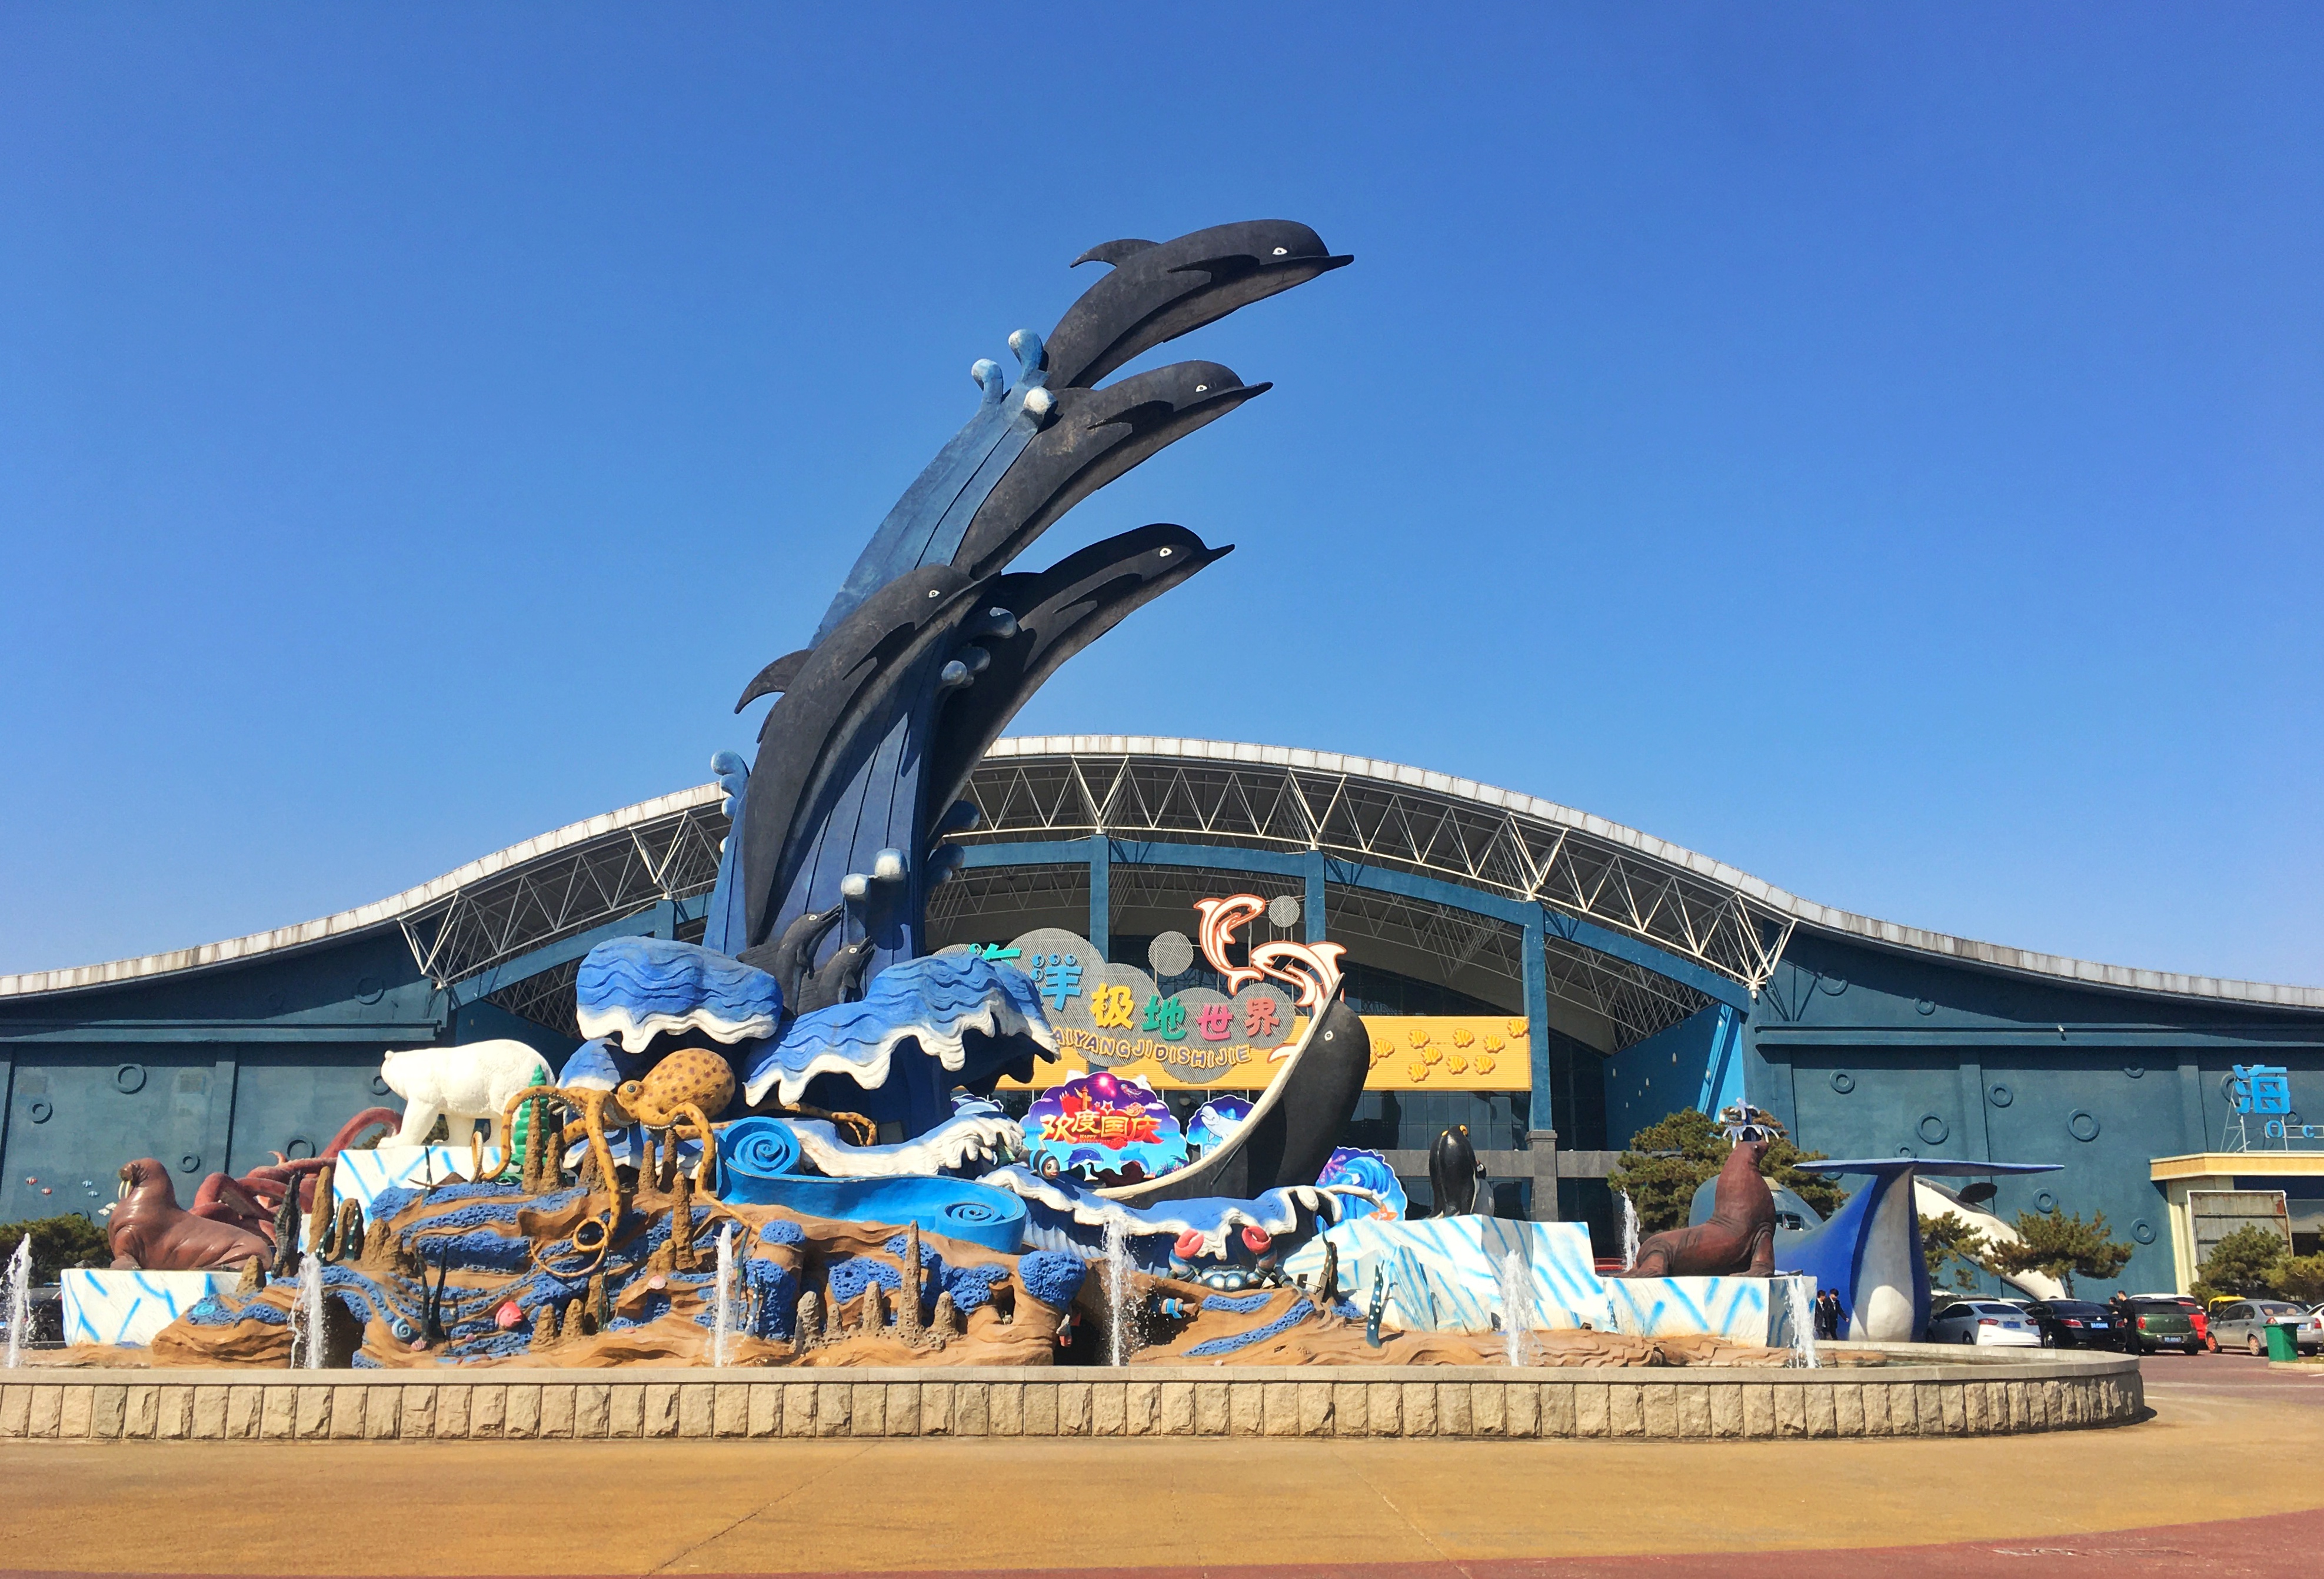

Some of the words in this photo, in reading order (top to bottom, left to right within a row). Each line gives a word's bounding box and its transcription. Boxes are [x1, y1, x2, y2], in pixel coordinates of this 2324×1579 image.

[2232, 1064, 2290, 1114] 海
[1038, 1109, 1164, 1144] 欢度国庆
